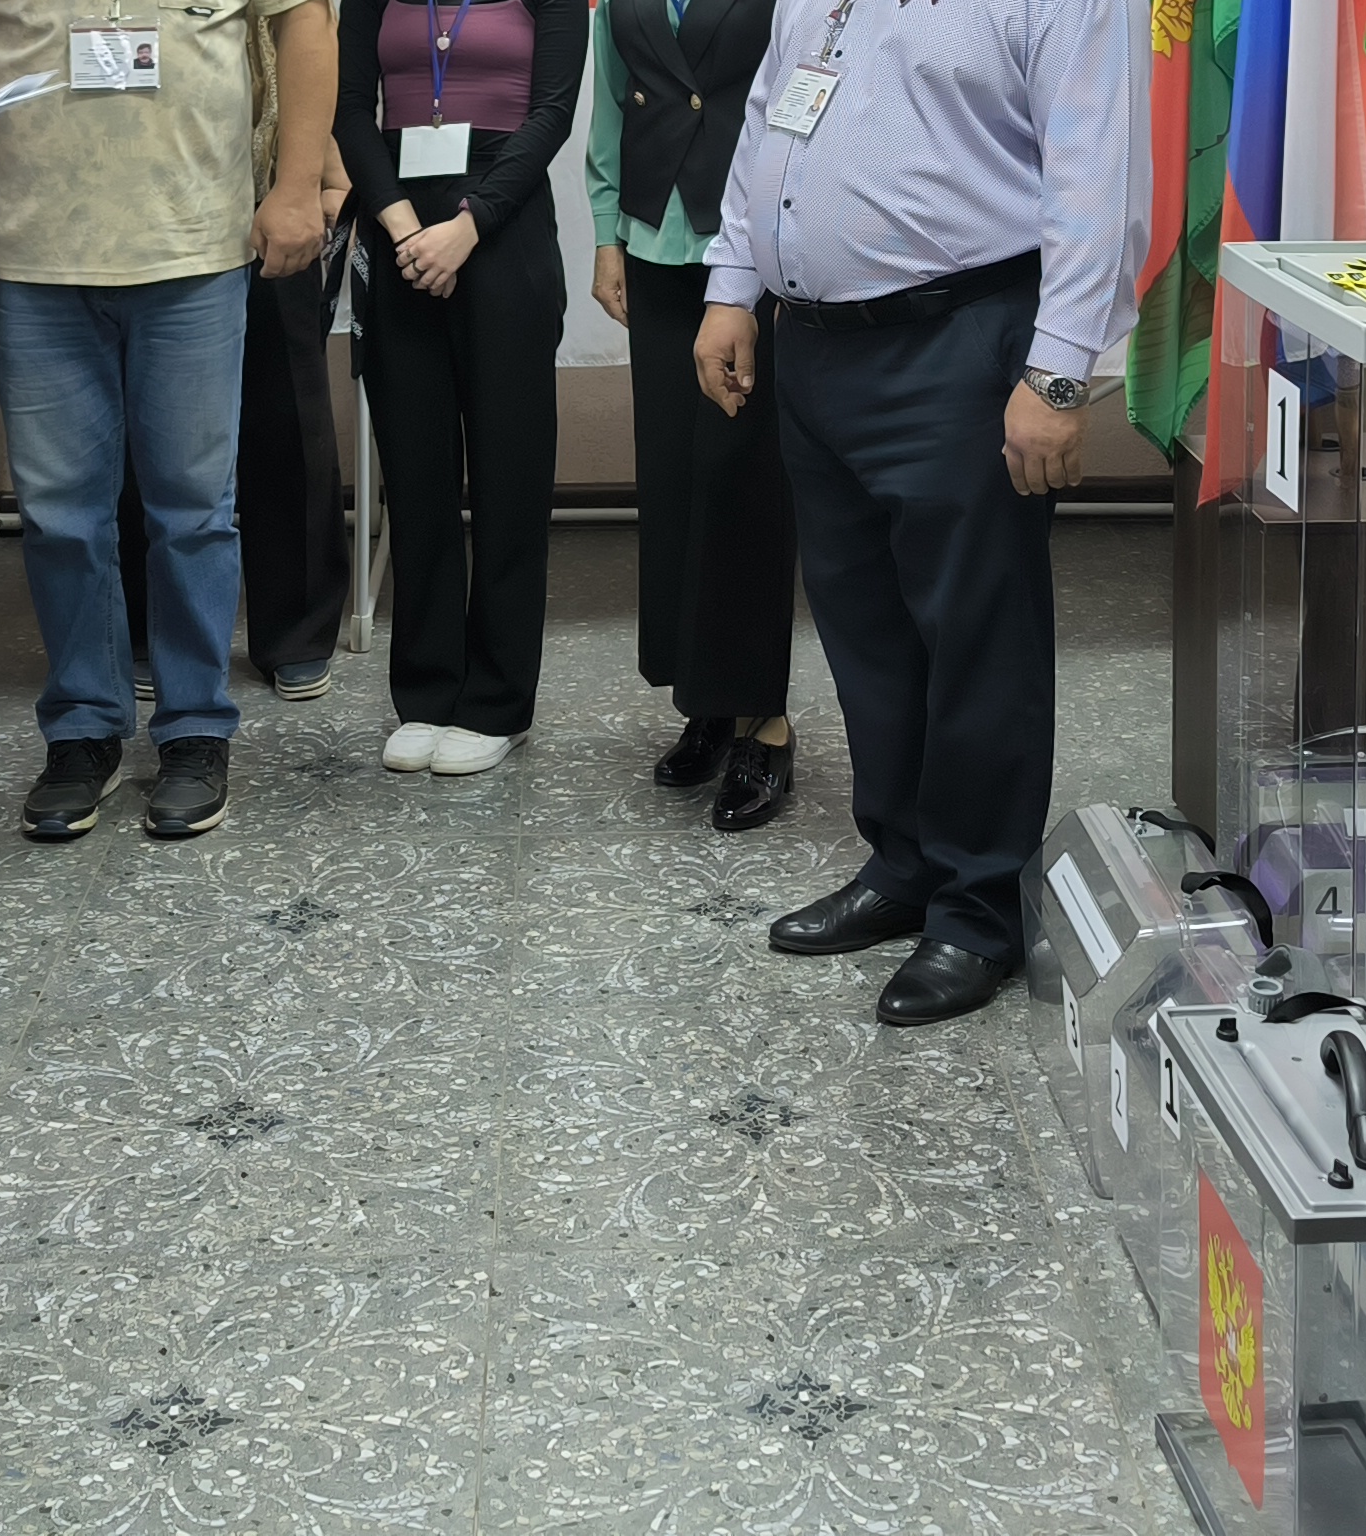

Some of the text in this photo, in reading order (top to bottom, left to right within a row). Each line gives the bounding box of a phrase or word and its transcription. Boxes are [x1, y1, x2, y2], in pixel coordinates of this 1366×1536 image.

[1275, 395, 1289, 482] 1
[1315, 886, 1343, 916] 4
[1068, 1001, 1078, 1049] 3
[1114, 1067, 1123, 1118] 2
[1164, 1057, 1179, 1123] 1
